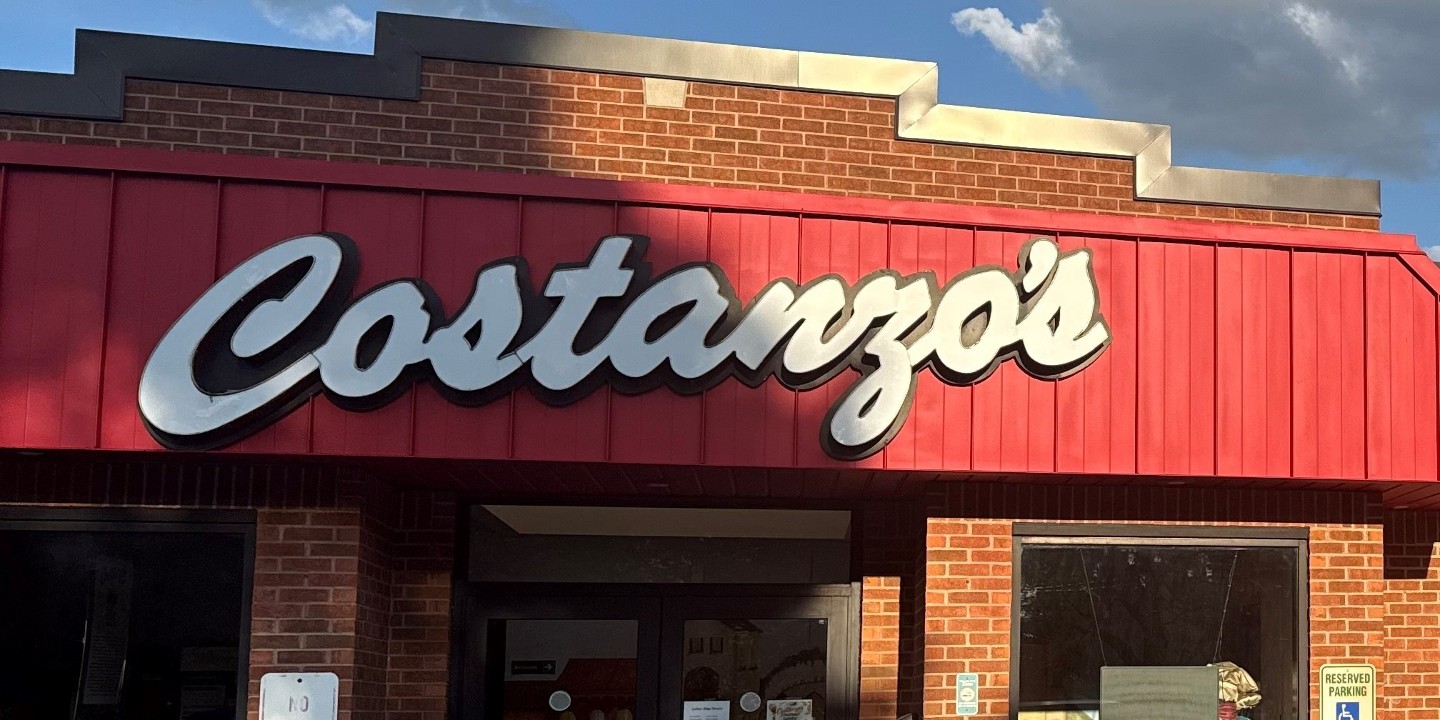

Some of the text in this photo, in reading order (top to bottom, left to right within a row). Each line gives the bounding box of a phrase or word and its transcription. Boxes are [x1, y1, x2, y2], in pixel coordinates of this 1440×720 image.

[138, 233, 1109, 448] Costanzo's
[1325, 673, 1371, 684] RESERVED
[1328, 686, 1367, 697] PARKING
[289, 695, 309, 712] NO
